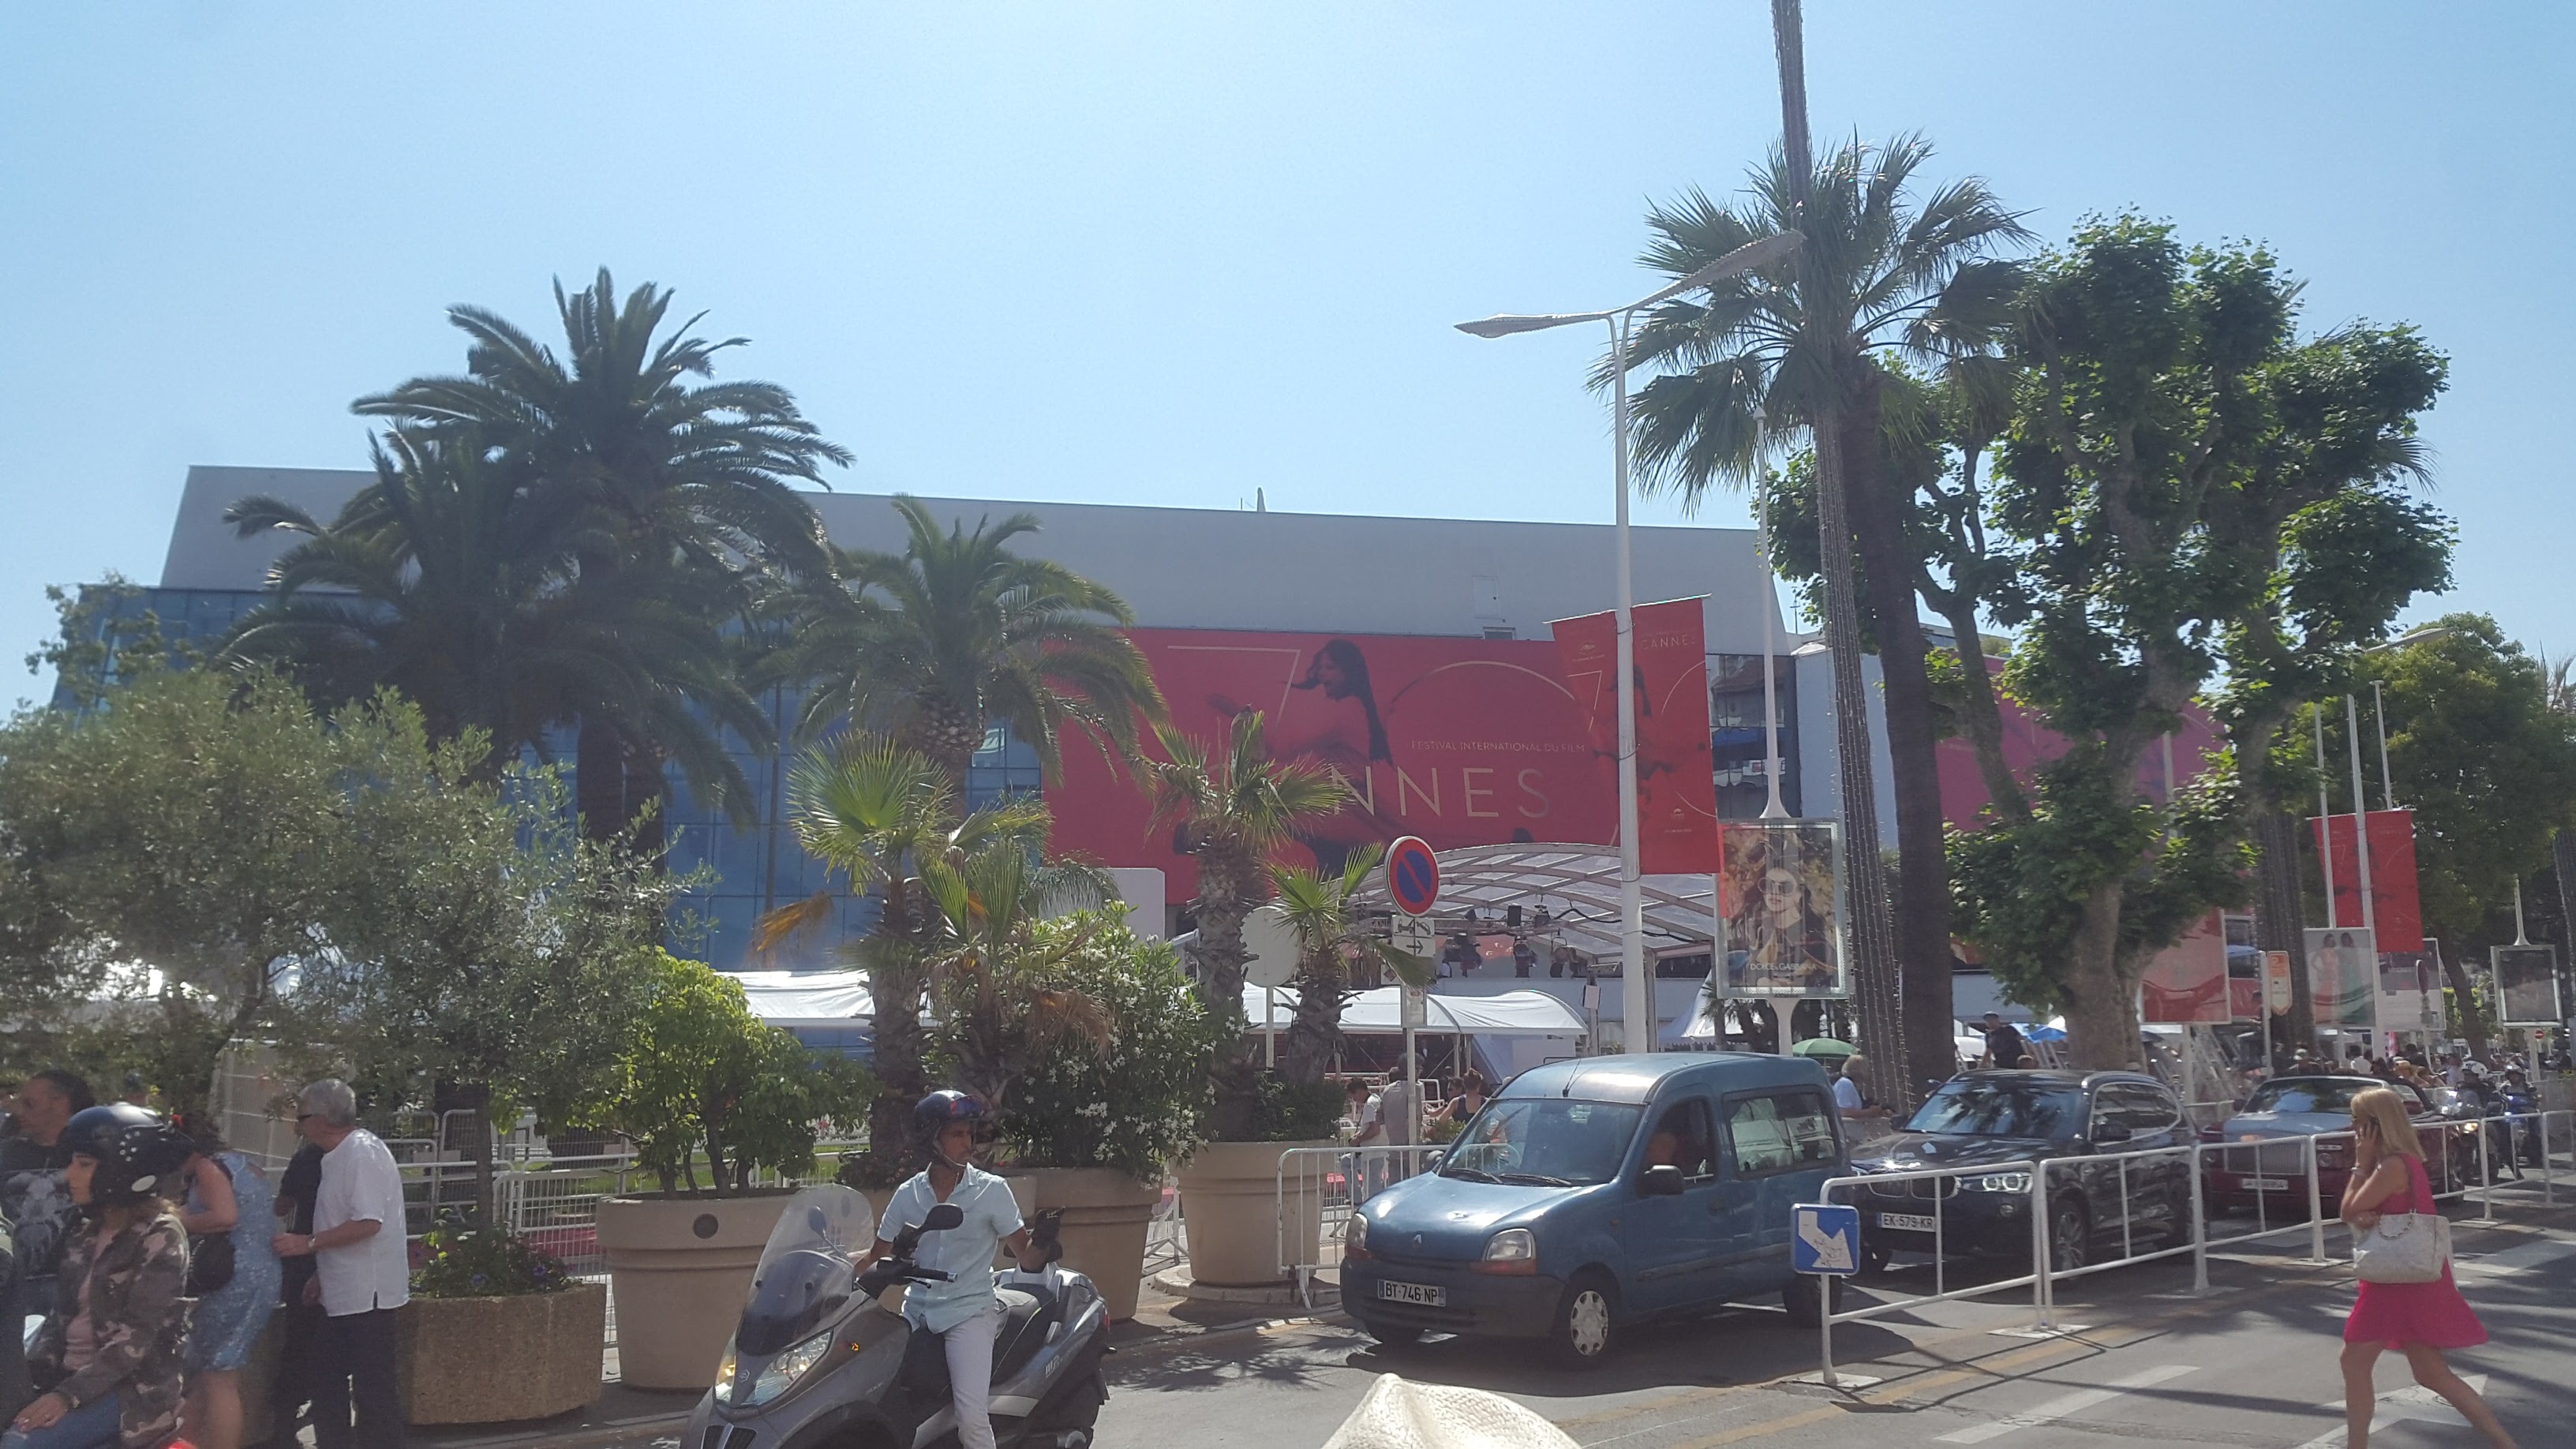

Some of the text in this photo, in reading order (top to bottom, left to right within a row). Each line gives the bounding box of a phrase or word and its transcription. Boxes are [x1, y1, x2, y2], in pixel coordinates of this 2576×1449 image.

[1411, 740, 1586, 752] FESTIVAL INTERNATIONAL DU FILM
[1331, 765, 1550, 819] NNES
